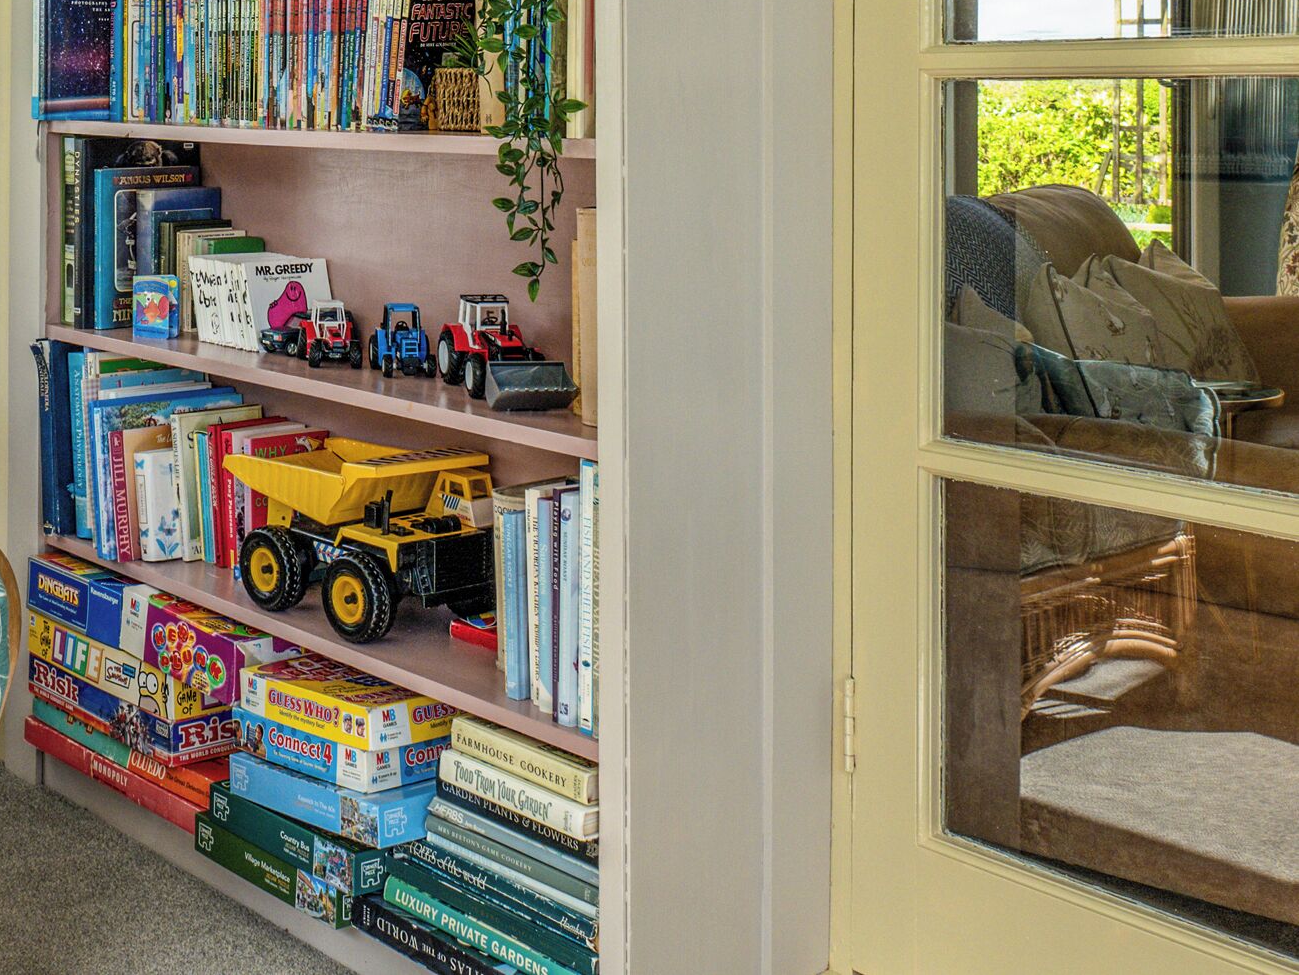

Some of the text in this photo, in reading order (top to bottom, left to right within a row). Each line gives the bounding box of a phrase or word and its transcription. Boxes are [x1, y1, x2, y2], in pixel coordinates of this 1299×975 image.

[410, 2, 474, 21] FANTASTIC
[408, 20, 470, 43] FUTURE
[120, 173, 186, 185] ANGUS WILSON
[255, 262, 314, 276] MR. GREEDY
[73, 369, 82, 417] ANATOMY
[75, 429, 83, 489] PHYSIOLOGY
[254, 444, 288, 459] WHY
[112, 456, 131, 555] JILL MURPHY
[552, 501, 560, 591] Playing with Food
[90, 586, 119, 606] Ravensburger
[582, 517, 591, 656] FISH AND SHELLFISH
[593, 546, 601, 680] BREAD MACHINE
[53, 629, 101, 680] LIFE
[247, 677, 258, 690] MB
[268, 689, 340, 728] GUESS WHO?
[382, 708, 396, 723] MB
[179, 719, 235, 751] Ris
[268, 727, 322, 761] Connect
[323, 743, 333, 765] 4
[130, 750, 168, 780] CLUEDO
[190, 749, 209, 759] WORLD
[345, 748, 357, 762] MB
[376, 751, 390, 765] MB
[376, 763, 391, 771] GAMES
[456, 732, 515, 766] FARMHOUSE
[519, 760, 568, 788] COOKERY
[92, 757, 129, 787] MONOPOLY
[453, 760, 474, 785] FOOD
[474, 769, 496, 796] FROM
[496, 778, 516, 808] YOUR
[517, 789, 553, 821] GARDEN
[433, 802, 464, 825] HERBS
[441, 781, 481, 806] GARDEN
[482, 797, 520, 823] PLANTS
[521, 815, 530, 828] &
[532, 819, 580, 852] FLOWERS
[280, 830, 311, 853] Country Bus
[437, 825, 451, 836] MRS
[481, 843, 500, 858] GAME
[500, 853, 533, 873] COOKERY
[244, 851, 291, 884] Village Marketplace
[376, 916, 419, 952] WORLD
[394, 888, 550, 975] LUXURY PRIVATE GARDENS
[560, 915, 587, 940] Hamlyn
[421, 943, 436, 957] THE
[436, 951, 447, 964] OF
